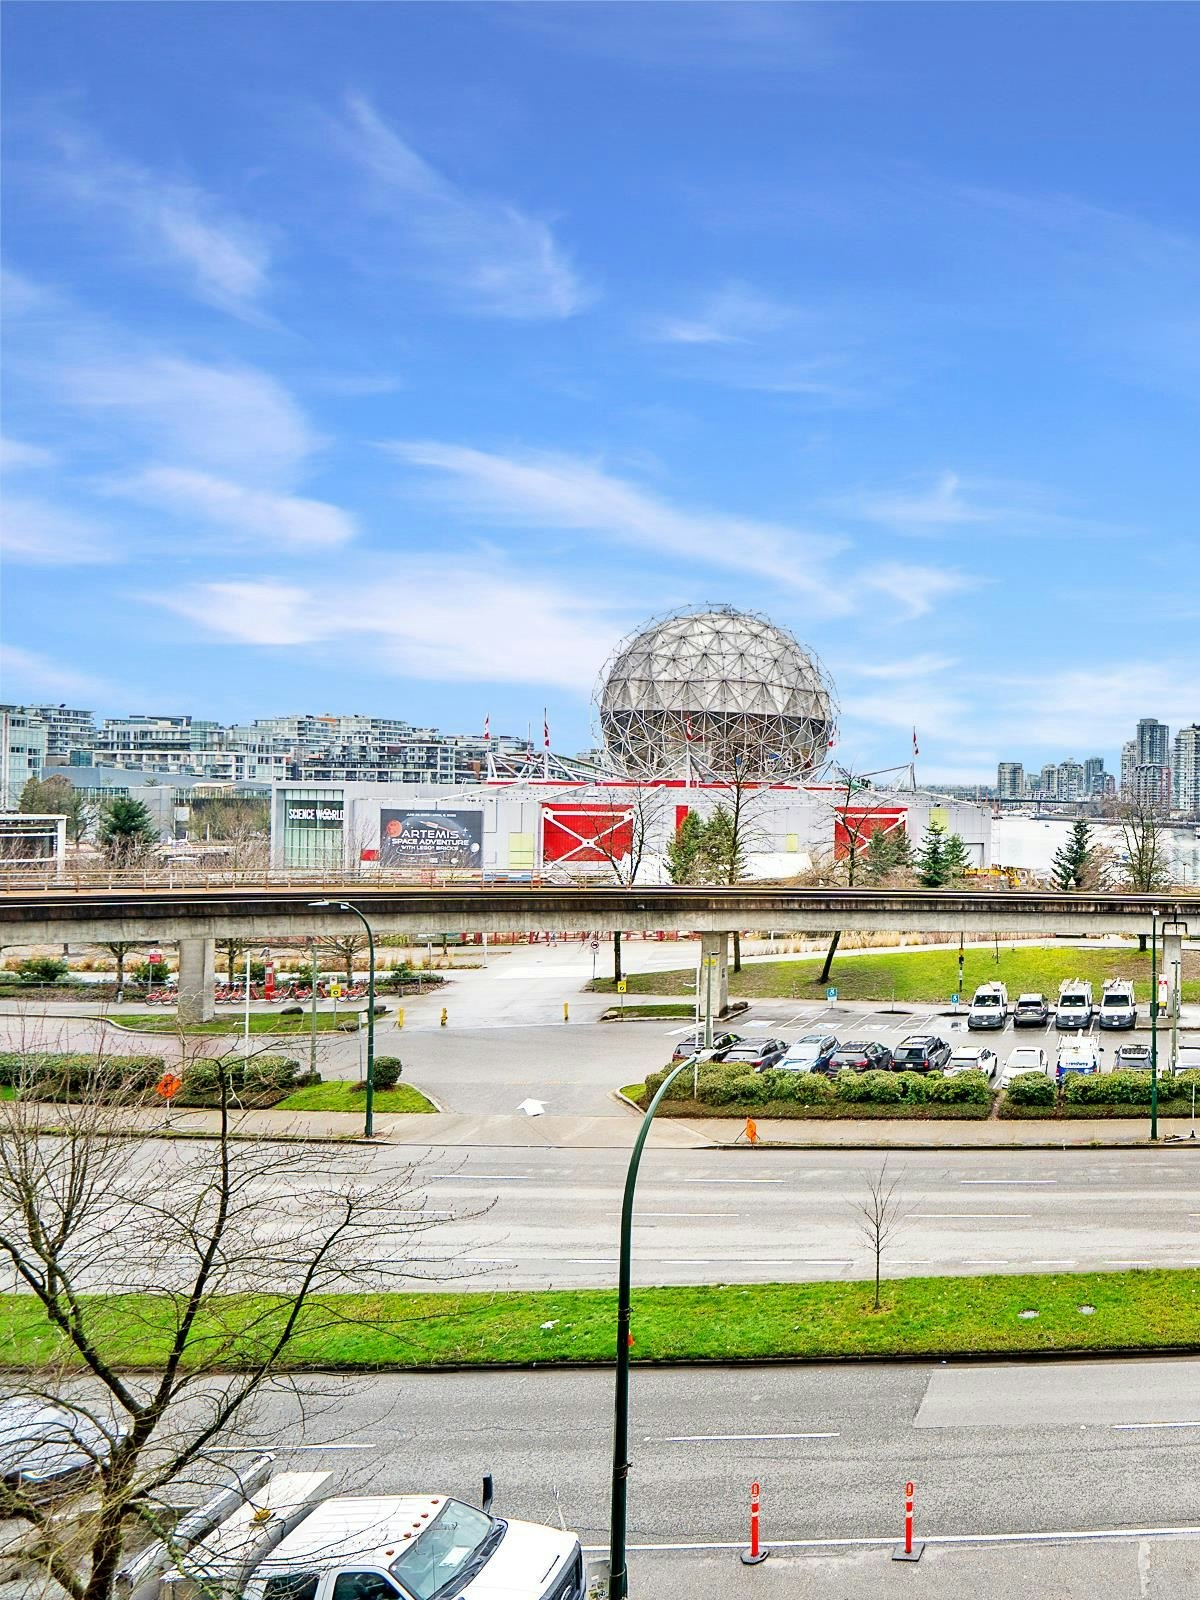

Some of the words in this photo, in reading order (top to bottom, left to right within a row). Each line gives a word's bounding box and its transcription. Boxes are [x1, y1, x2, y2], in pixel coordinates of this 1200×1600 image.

[288, 808, 315, 820] SCIENCE
[316, 808, 344, 821] WORLD
[401, 829, 460, 839] ARTEMIS
